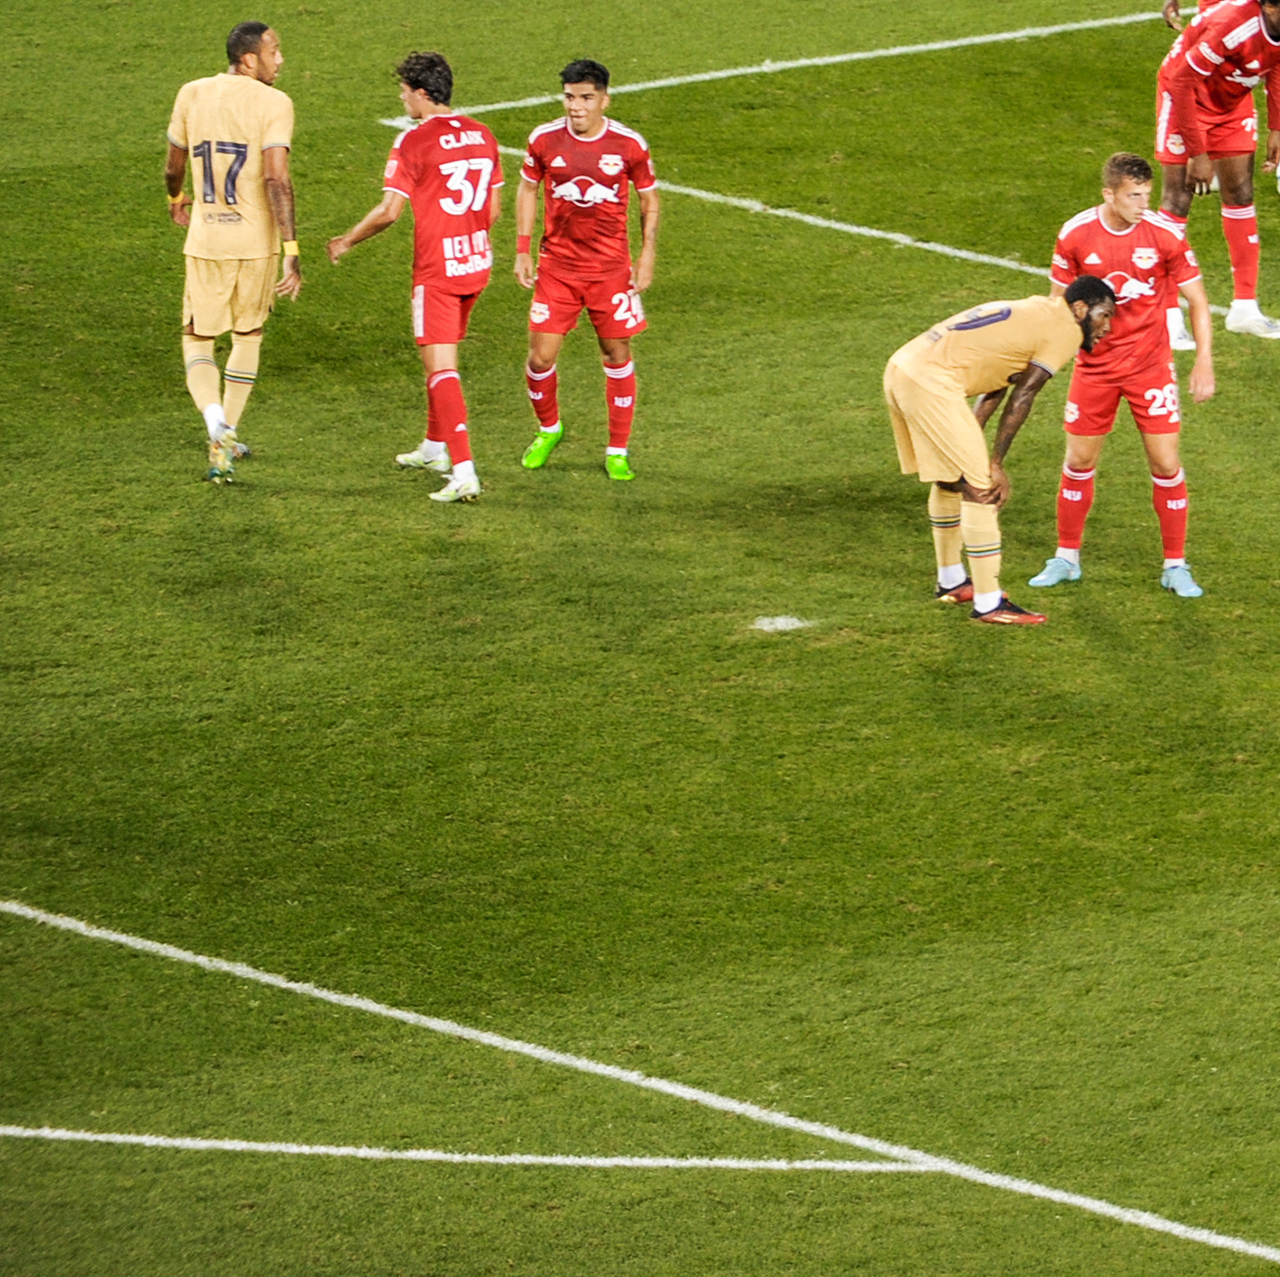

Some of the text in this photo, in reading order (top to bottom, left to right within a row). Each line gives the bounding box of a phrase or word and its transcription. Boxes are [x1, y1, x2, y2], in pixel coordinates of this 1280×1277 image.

[193, 140, 248, 205] 17
[439, 157, 494, 215] 37
[1144, 383, 1179, 416] 28
